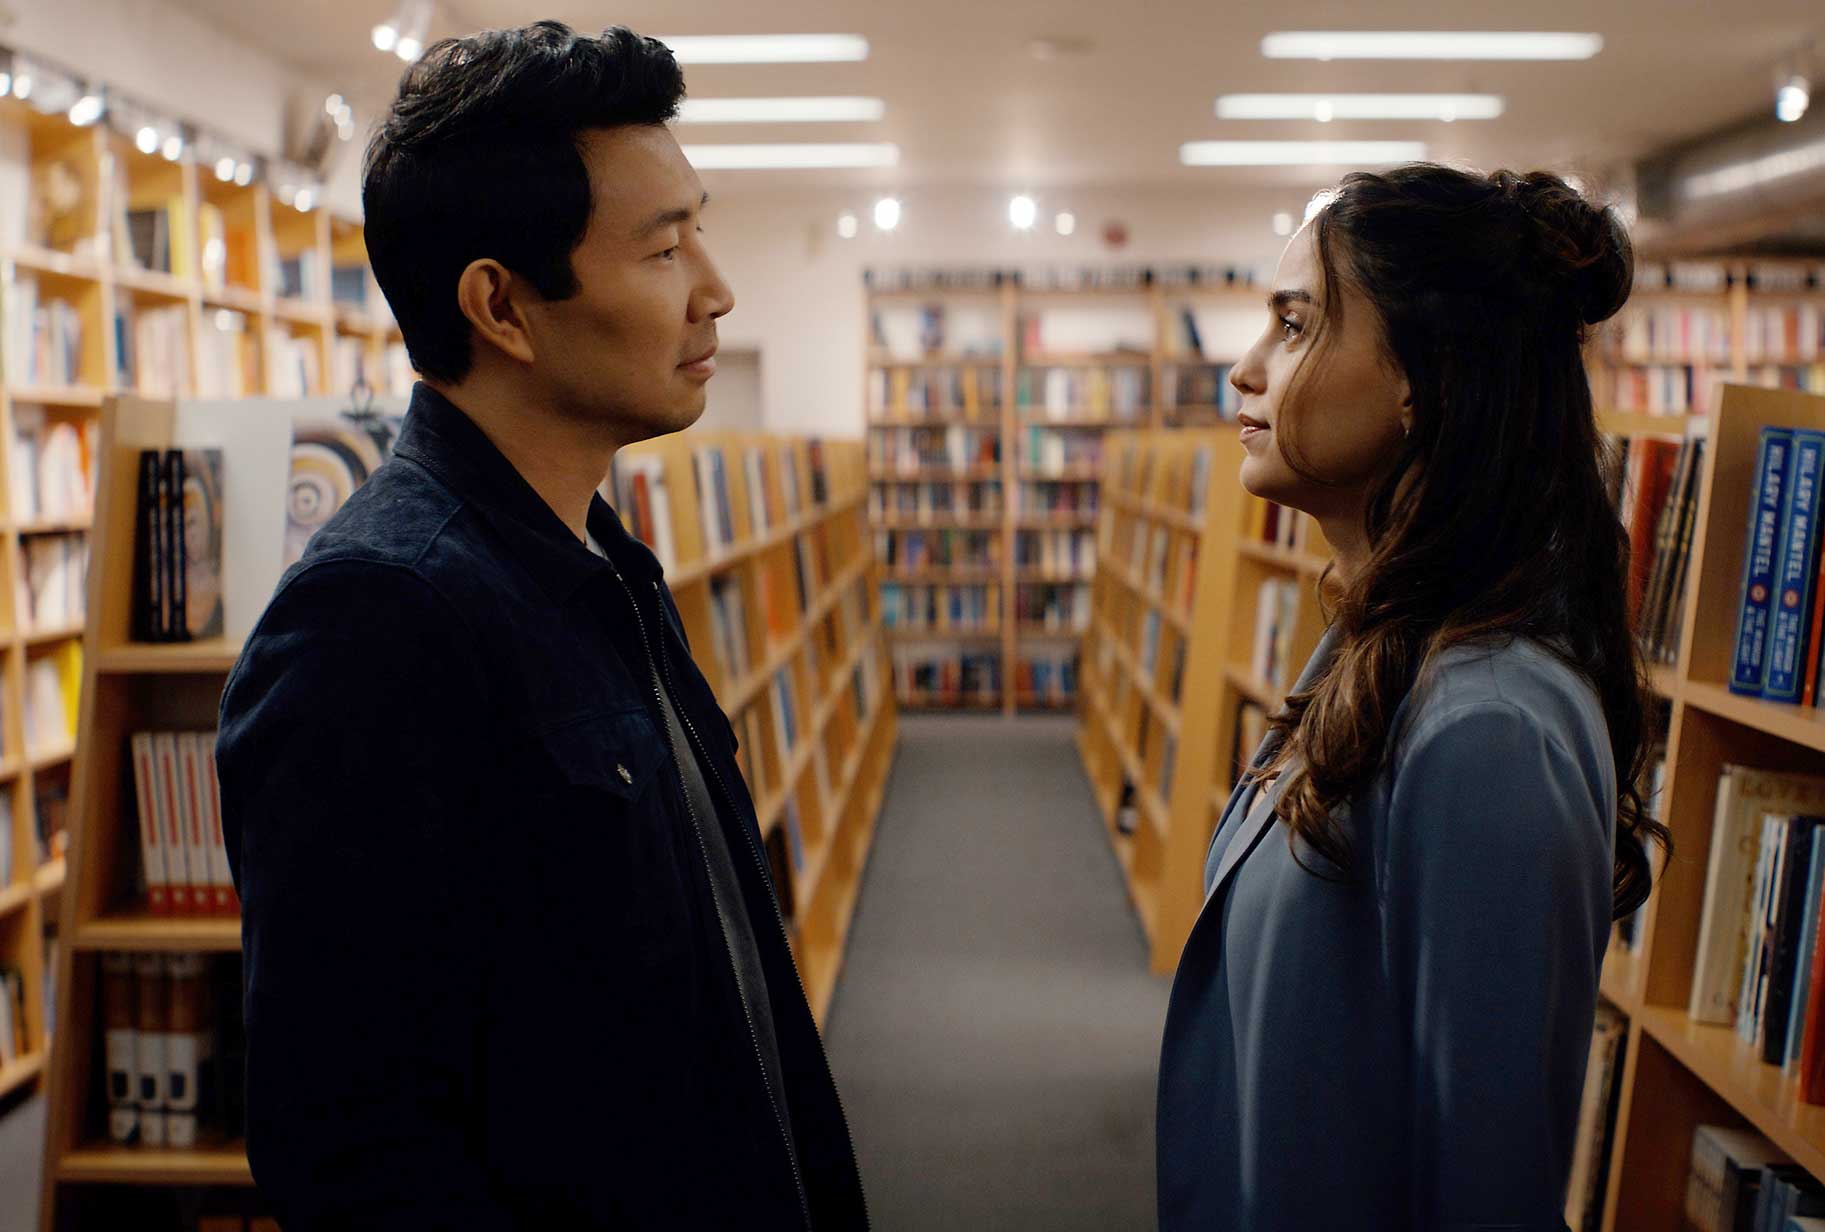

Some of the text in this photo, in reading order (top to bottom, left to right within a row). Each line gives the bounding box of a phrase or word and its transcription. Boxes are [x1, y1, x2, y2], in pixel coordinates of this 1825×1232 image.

[1753, 445, 1783, 576] HILARY MANTEL
[1787, 449, 1816, 581] HILARY MANTEL
